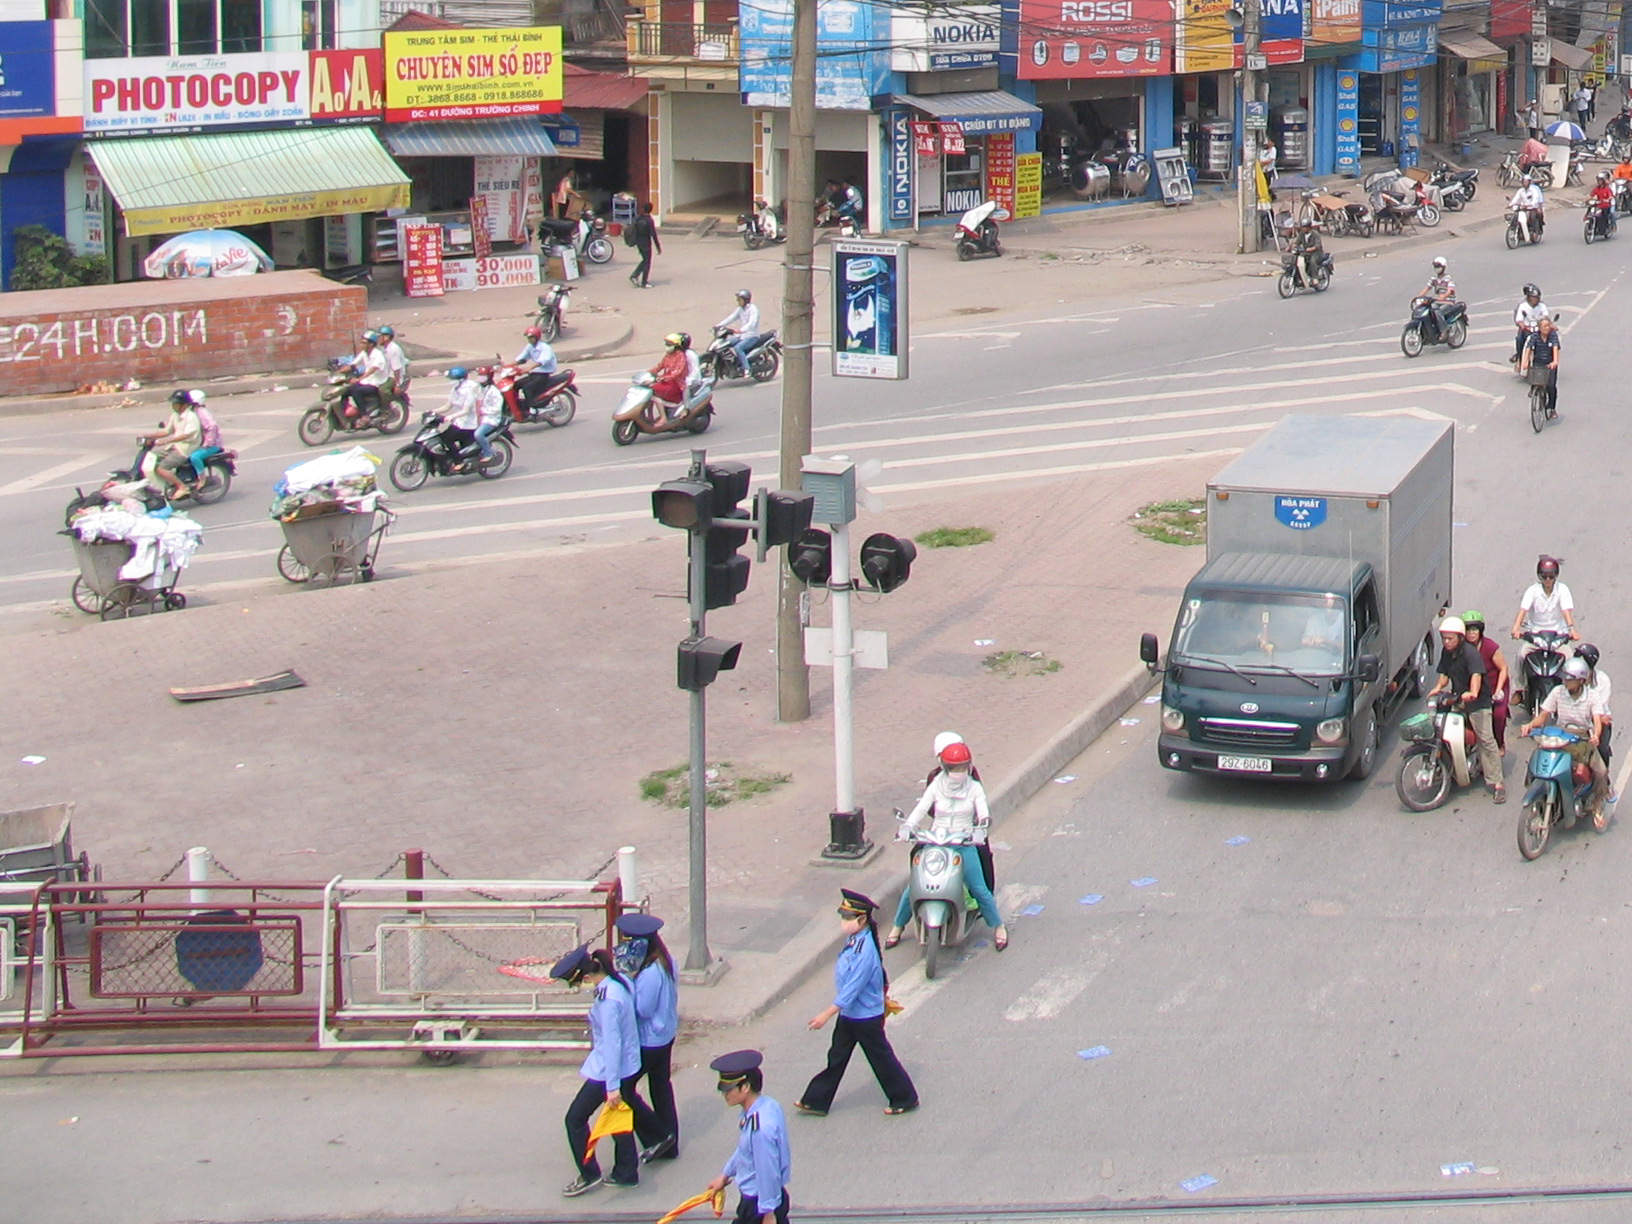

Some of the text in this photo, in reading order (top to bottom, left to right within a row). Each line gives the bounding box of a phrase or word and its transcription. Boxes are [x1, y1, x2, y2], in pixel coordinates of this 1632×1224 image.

[1061, 1, 1132, 22] ROSSI
[406, 37, 435, 46] TRUNG
[459, 35, 475, 44] SIM
[933, 23, 995, 43] NOKIA
[396, 44, 553, 80] CHUYÊN SIM SỐ ĐẸP
[92, 70, 301, 113] PHOTOCOPY
[429, 108, 438, 117] 41
[512, 104, 540, 113] CHINH
[896, 117, 908, 193] NOKIA
[947, 190, 981, 211] NOKIA
